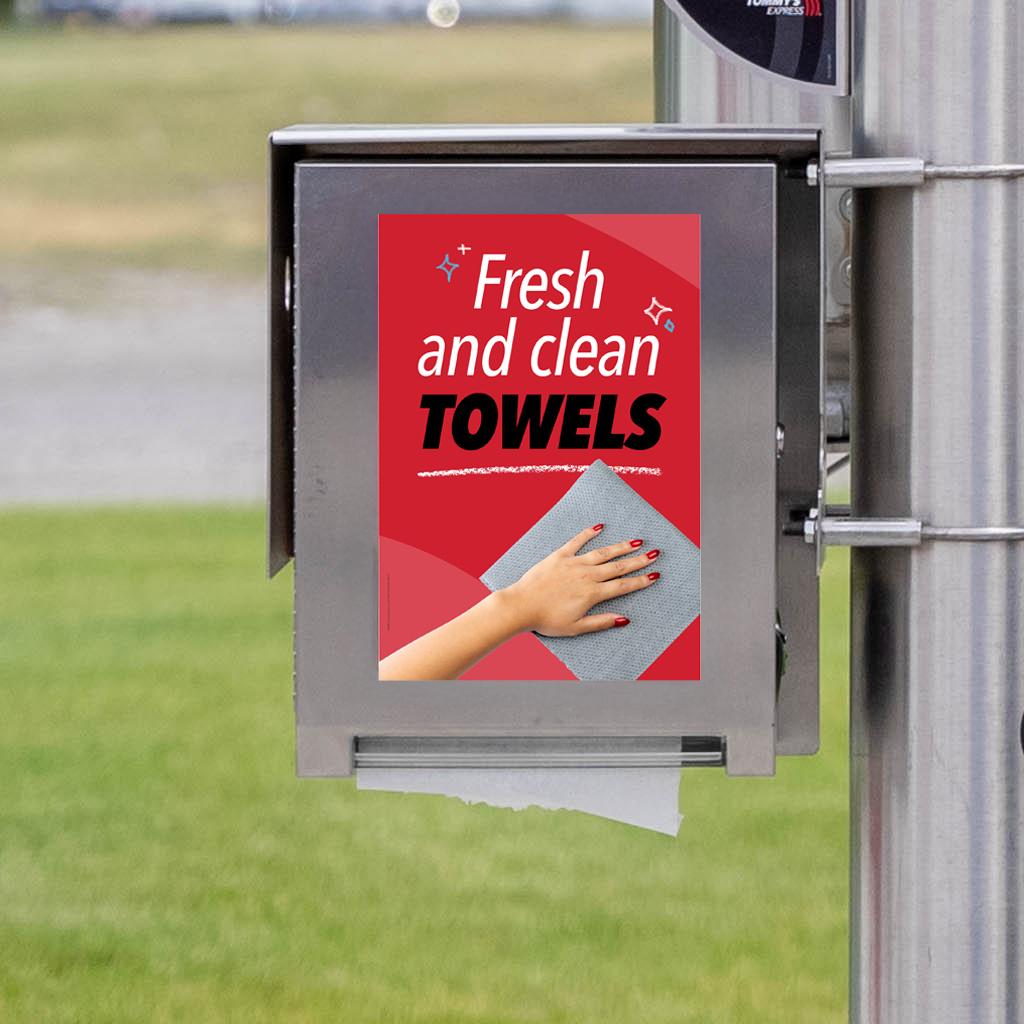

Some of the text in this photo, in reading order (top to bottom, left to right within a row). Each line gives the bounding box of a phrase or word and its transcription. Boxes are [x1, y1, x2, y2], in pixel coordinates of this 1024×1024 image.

[766, 6, 804, 16] EXPRESS
[473, 250, 605, 310] Fresh
[417, 317, 660, 377] and clean
[419, 392, 668, 451] TOWELS
